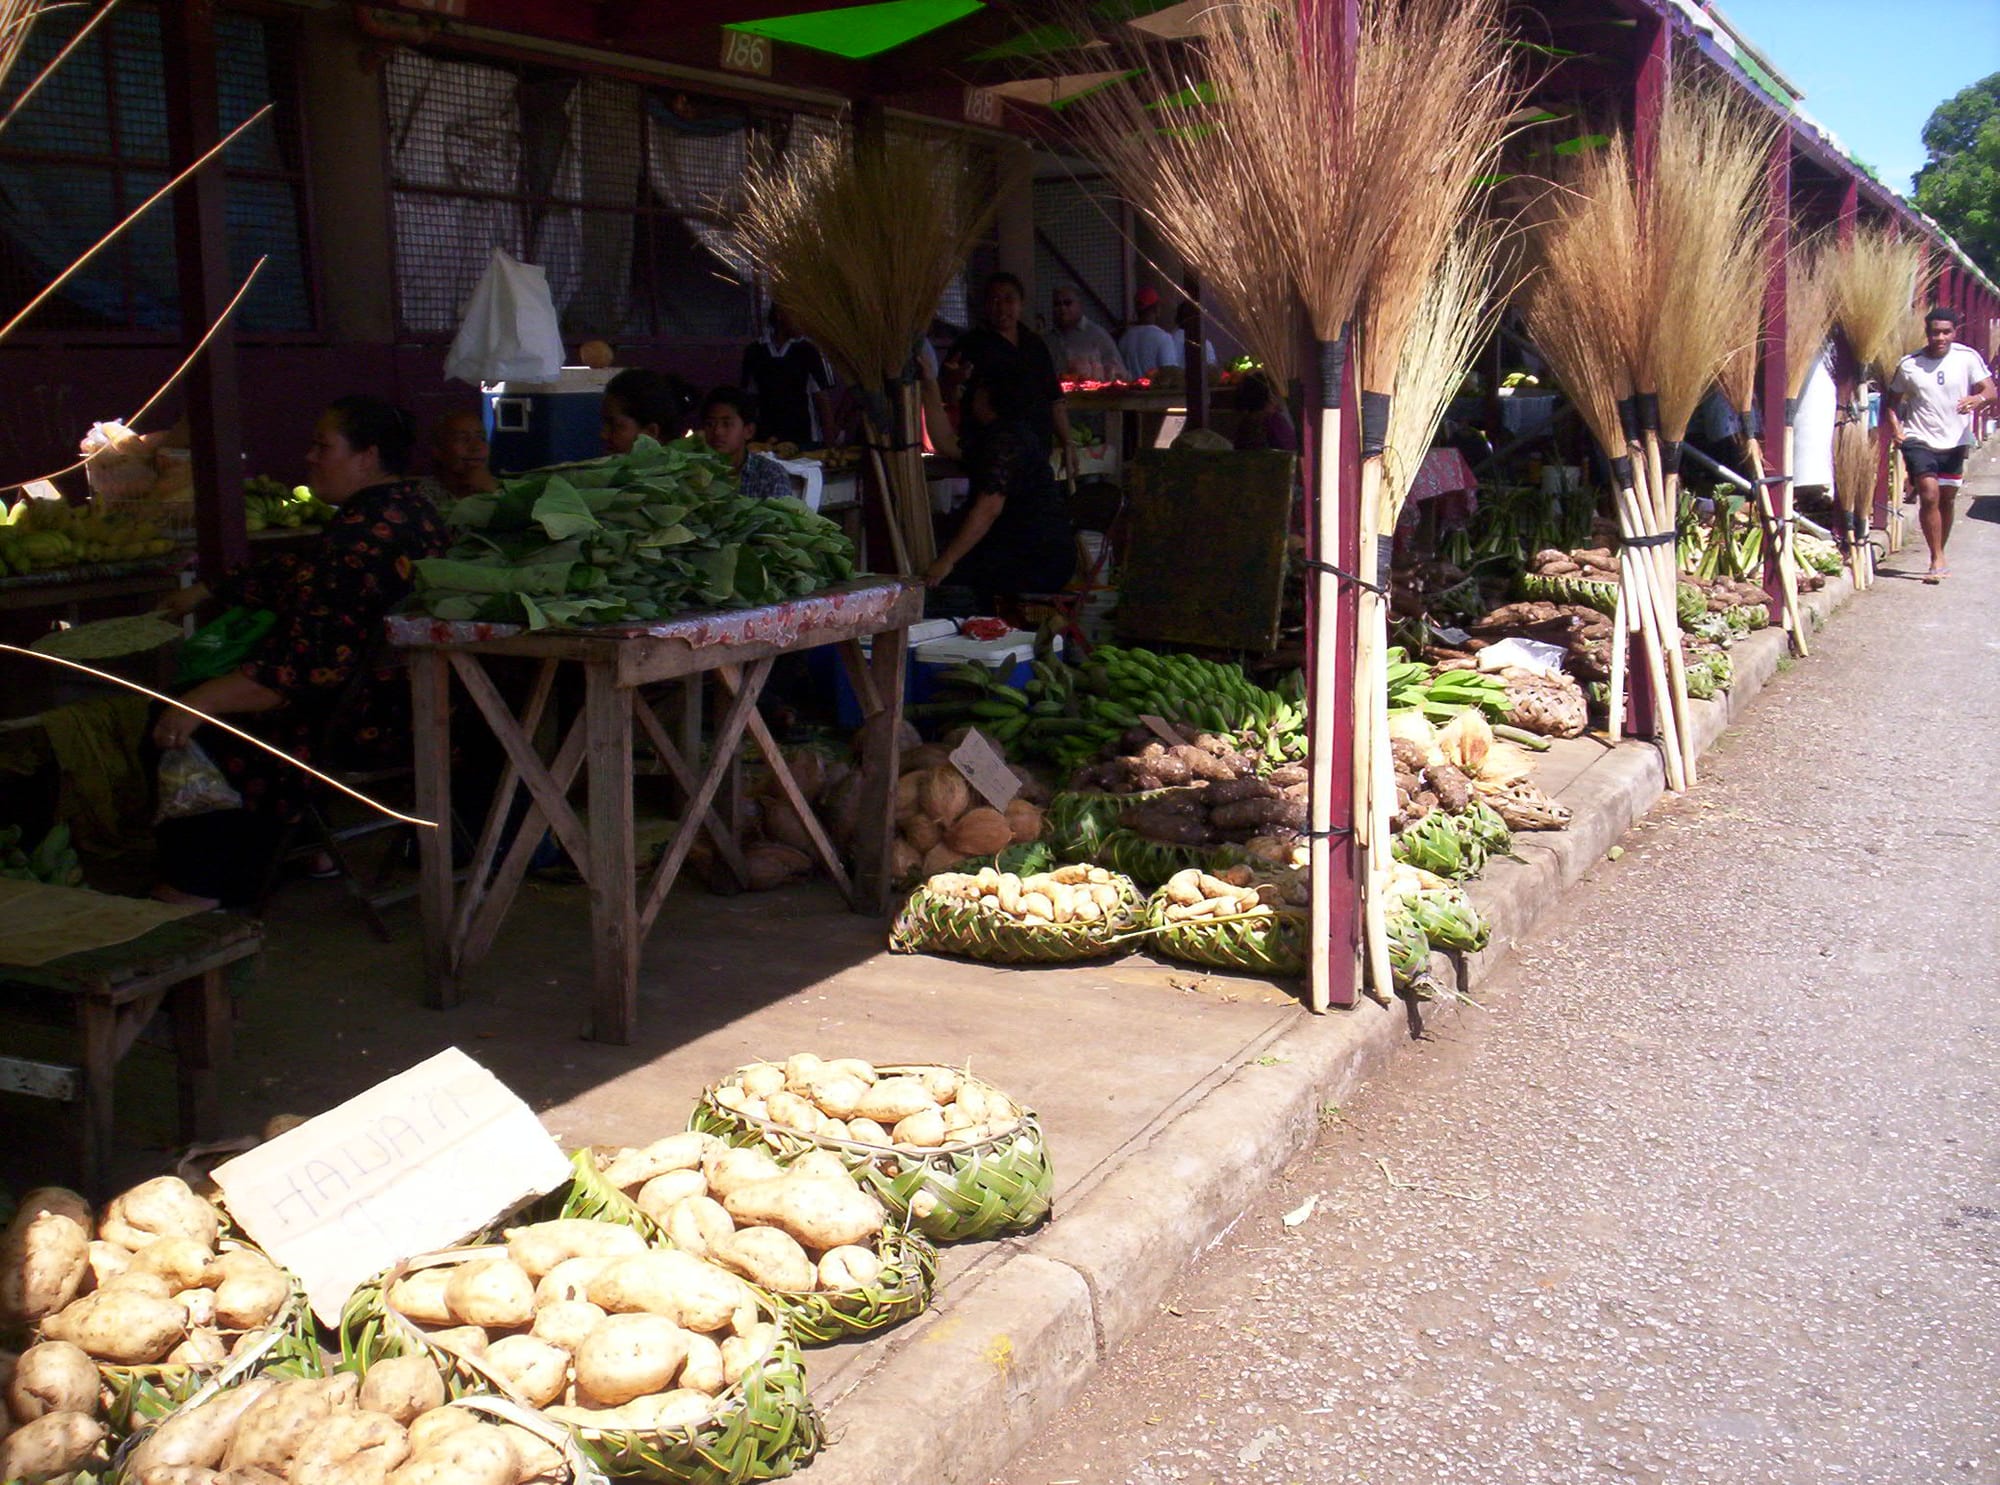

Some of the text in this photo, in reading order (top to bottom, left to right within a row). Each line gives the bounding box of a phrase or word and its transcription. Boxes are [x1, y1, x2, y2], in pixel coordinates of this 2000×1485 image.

[726, 31, 763, 69] 186
[965, 87, 993, 122] 188
[1937, 371, 1945, 385] 8
